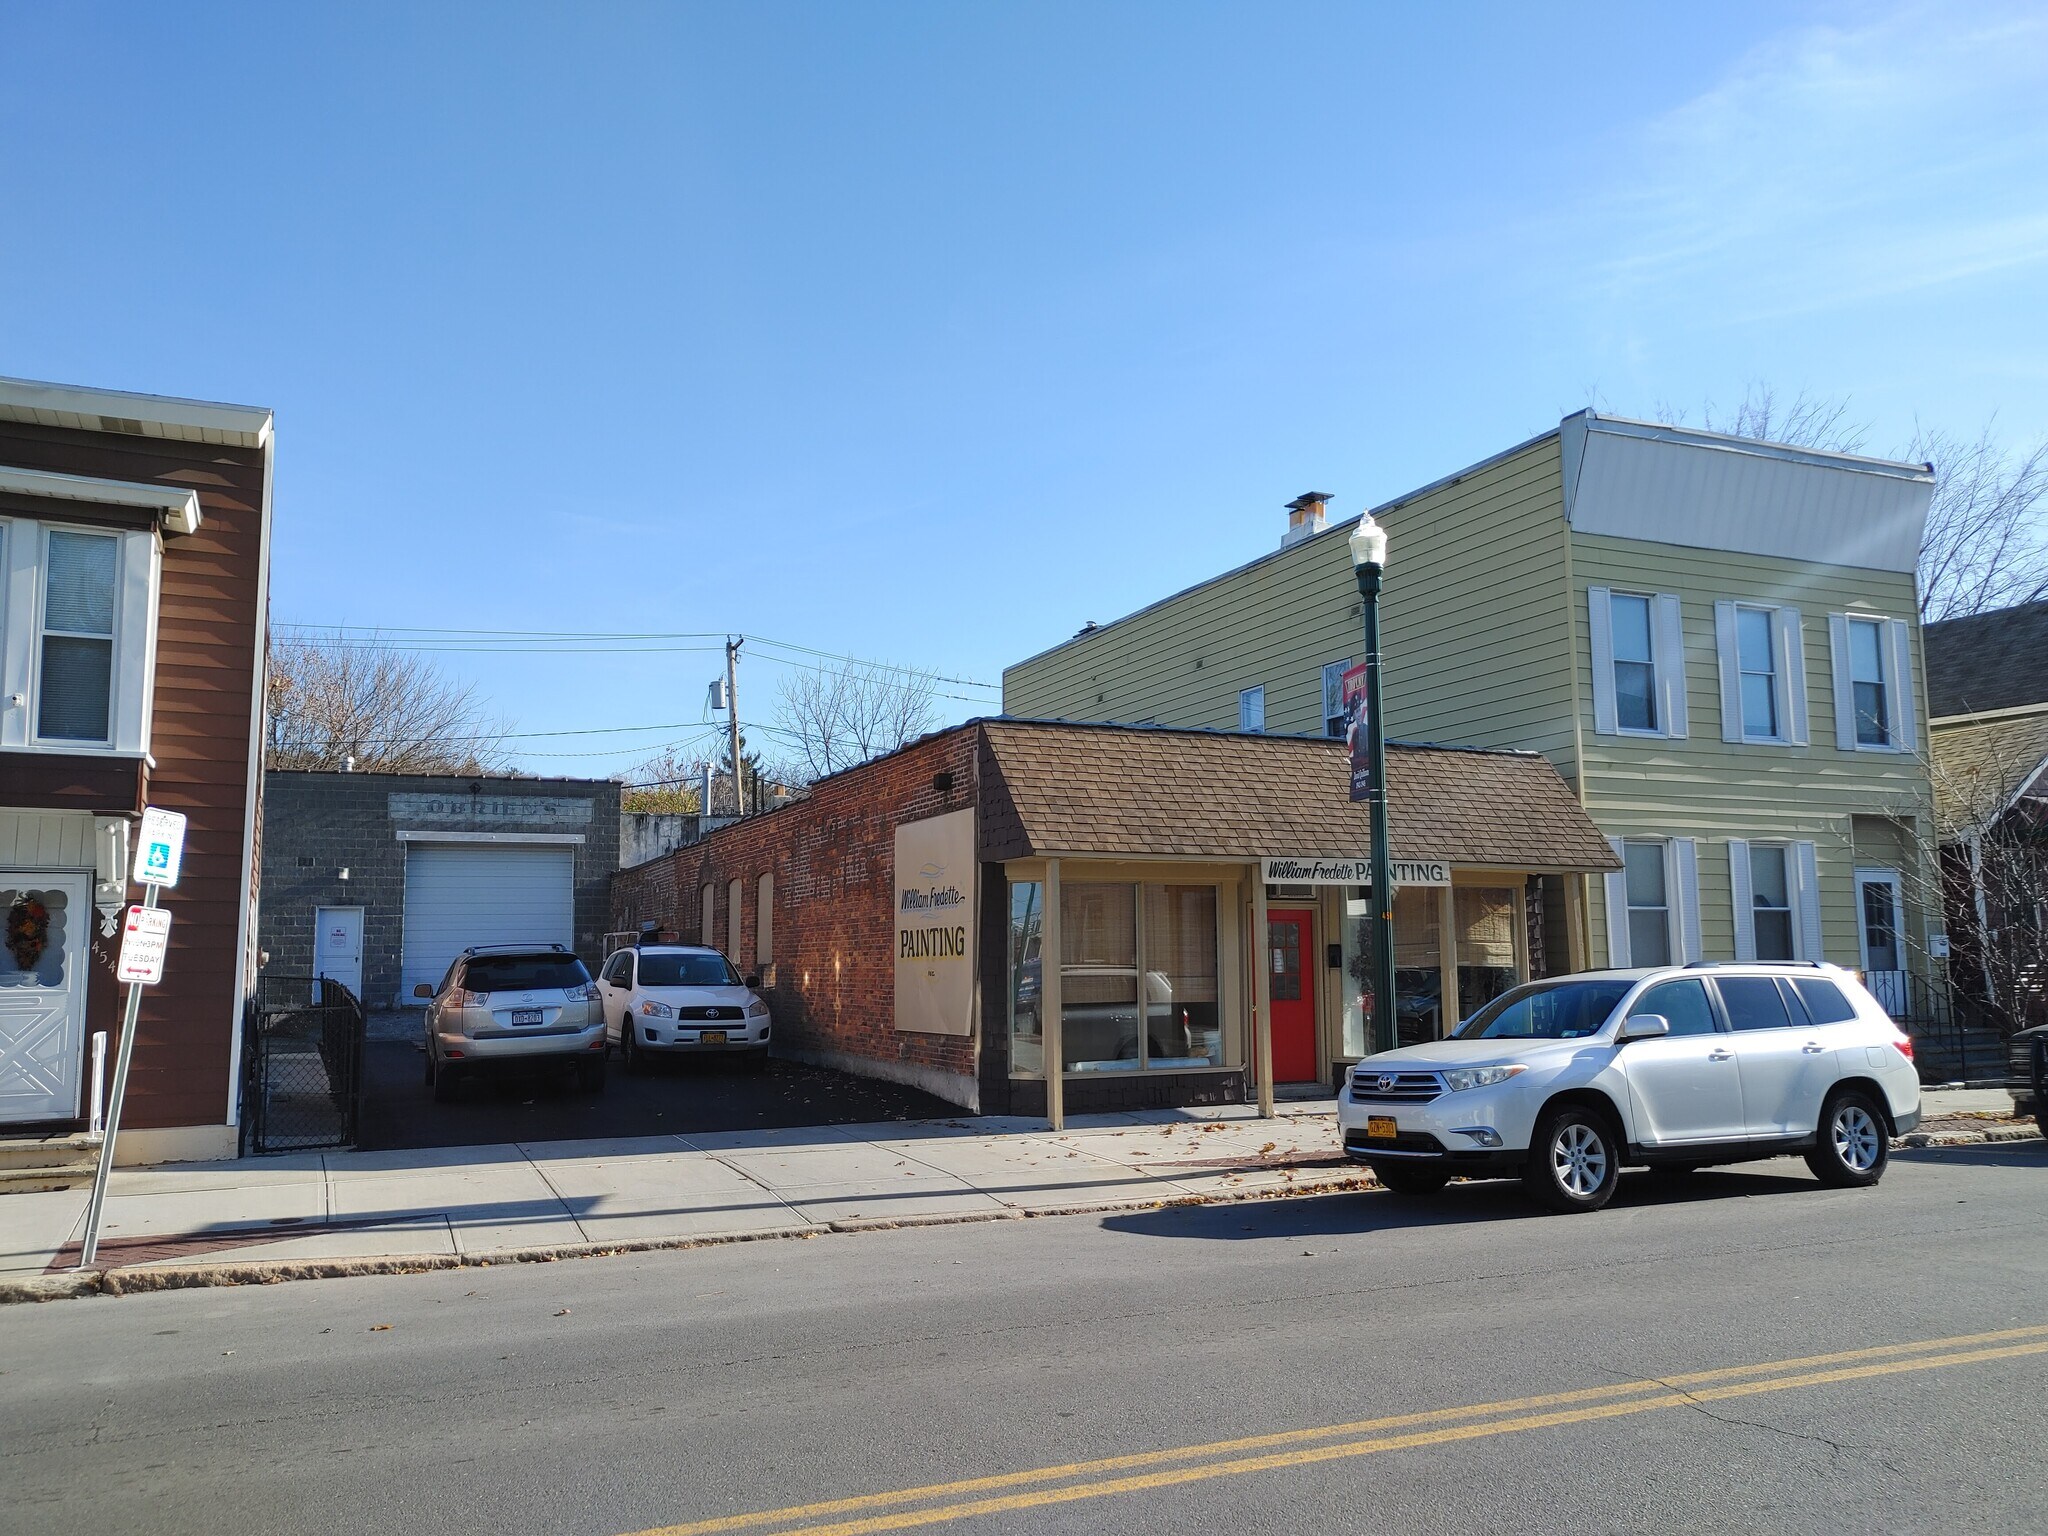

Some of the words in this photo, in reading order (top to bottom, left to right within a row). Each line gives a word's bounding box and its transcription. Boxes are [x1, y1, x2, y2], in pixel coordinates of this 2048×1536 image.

[1268, 861, 1312, 879] William
[1311, 861, 1354, 880] Fredette
[1355, 862, 1443, 882] PANTING
[901, 888, 929, 910] William
[929, 886, 965, 908] Fredette
[900, 926, 965, 958] PAINTING
[123, 952, 160, 963] TUESDAY
